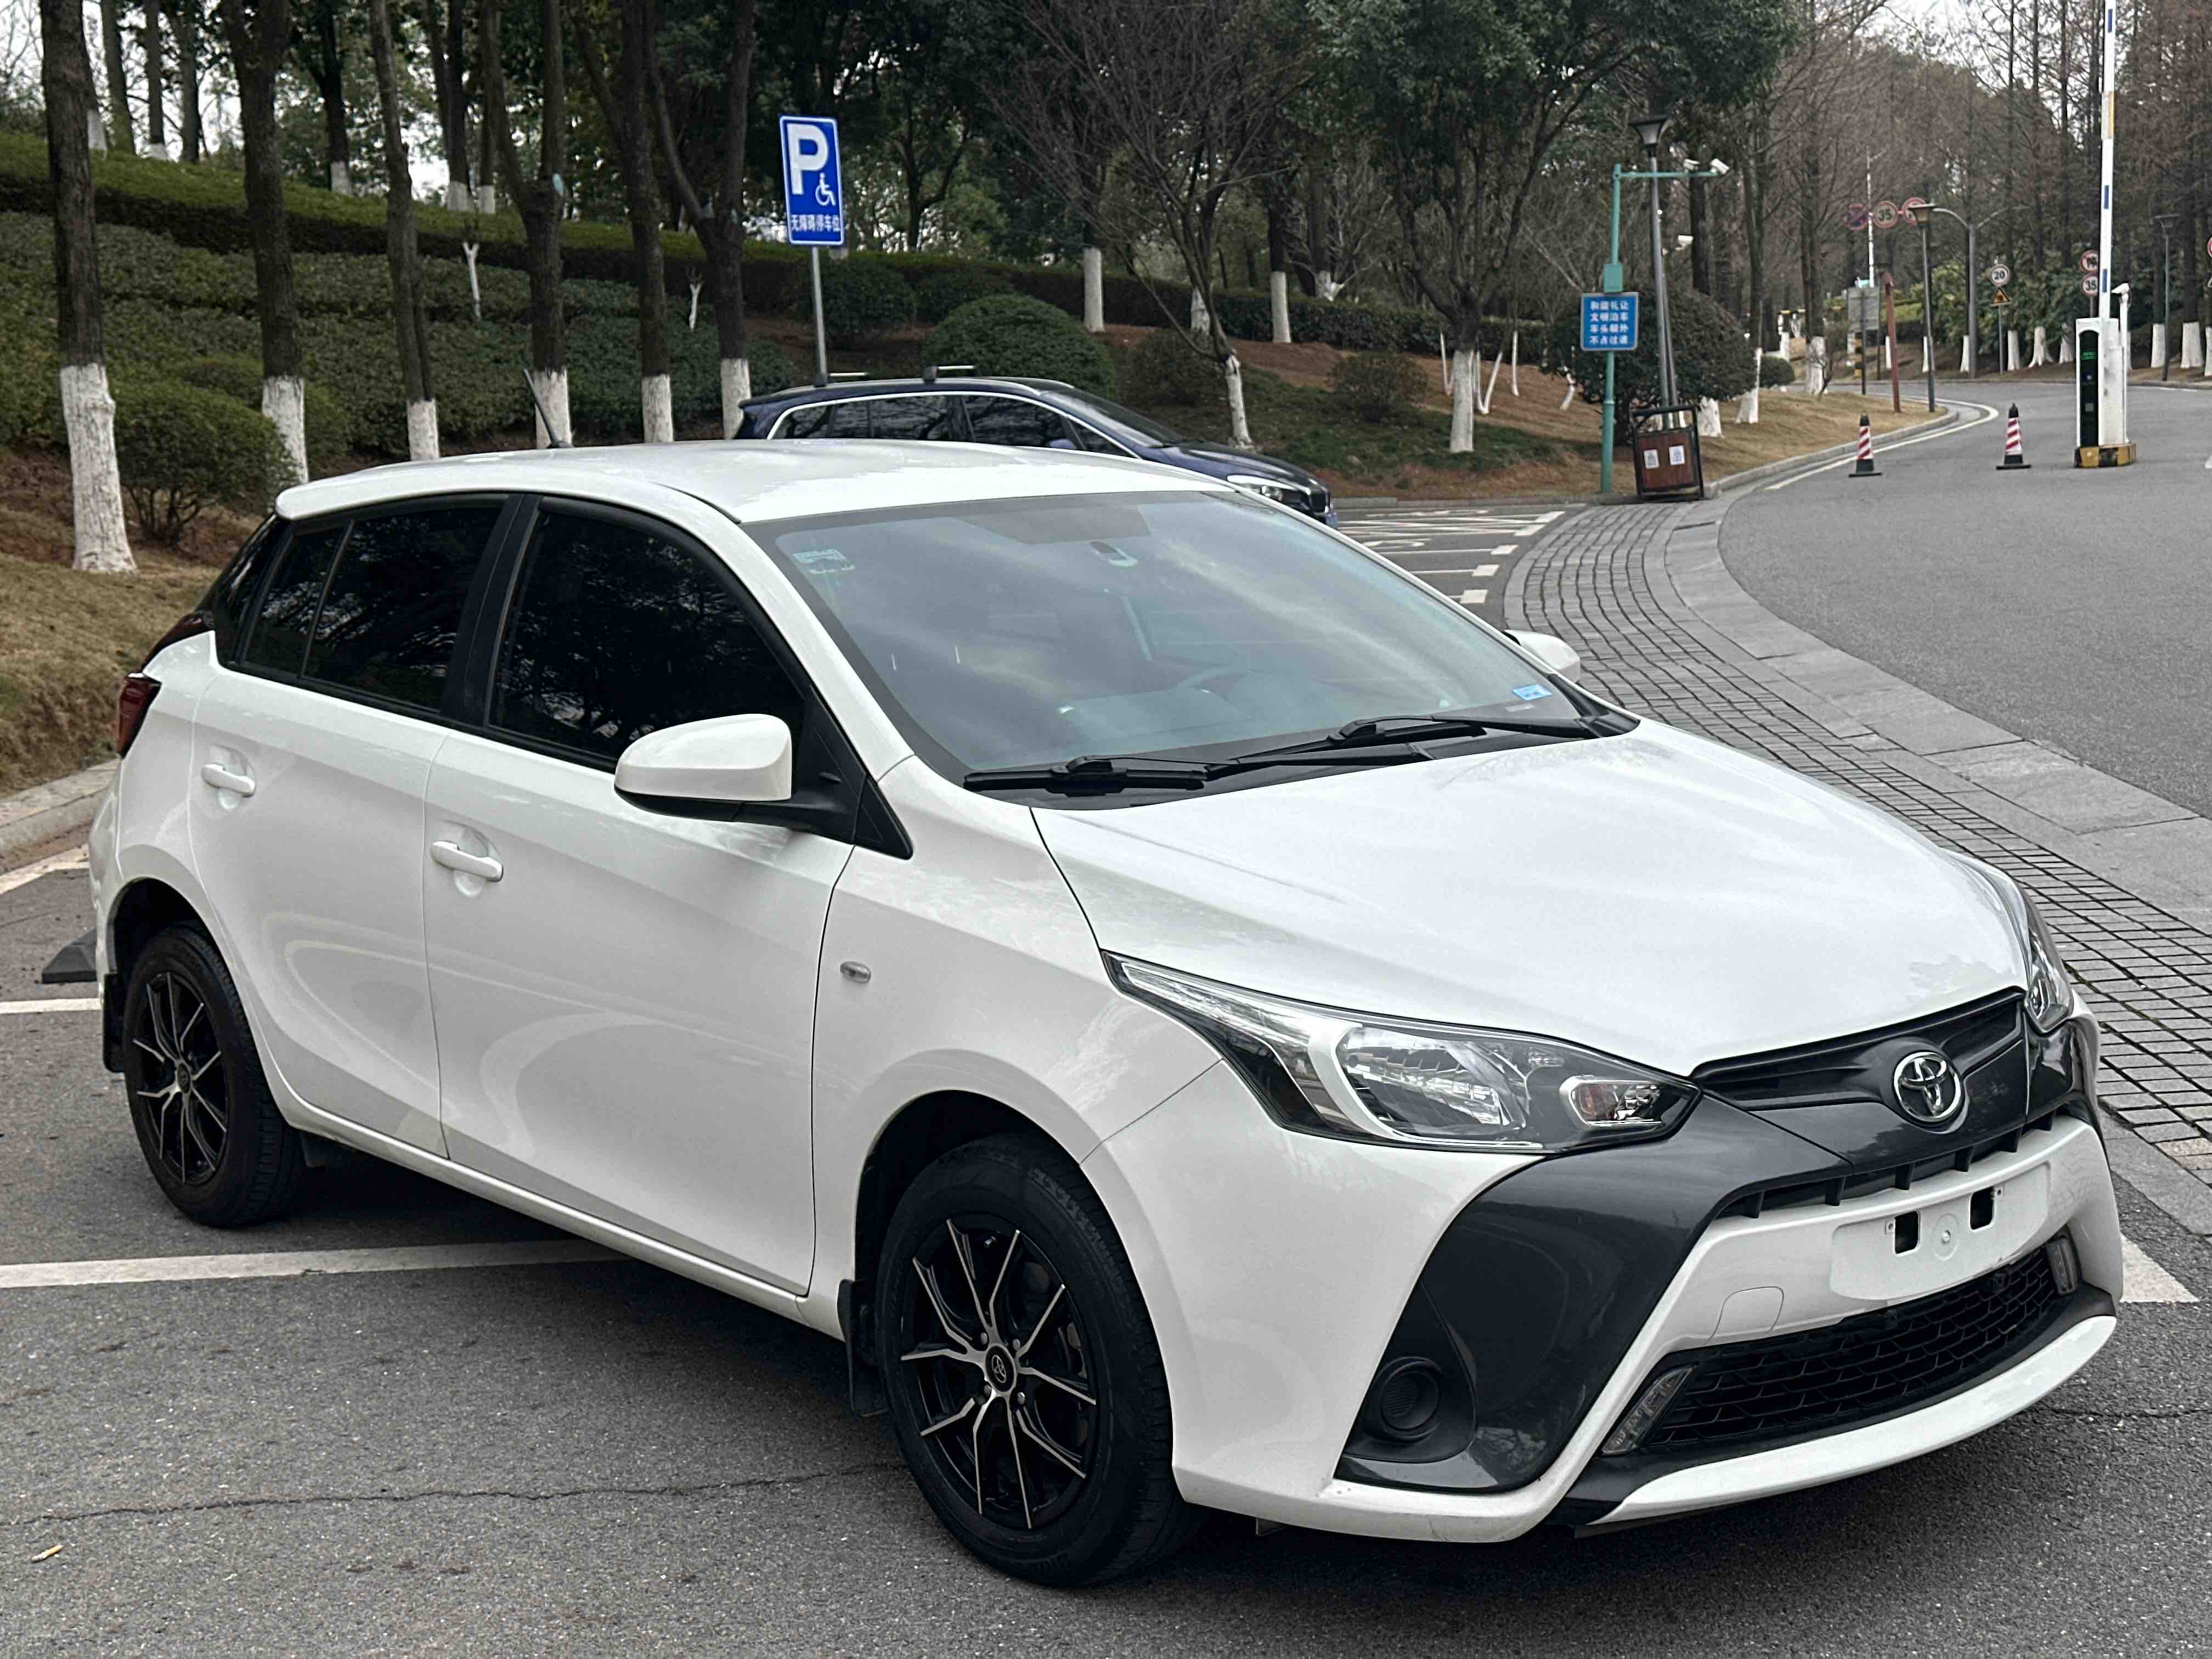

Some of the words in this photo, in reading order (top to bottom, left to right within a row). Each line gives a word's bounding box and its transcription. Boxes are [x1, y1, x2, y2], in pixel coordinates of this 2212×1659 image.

[787, 123, 828, 195] P
[1878, 209, 1892, 221] 35
[1994, 270, 2005, 279] 20
[2085, 280, 2096, 290] 35
